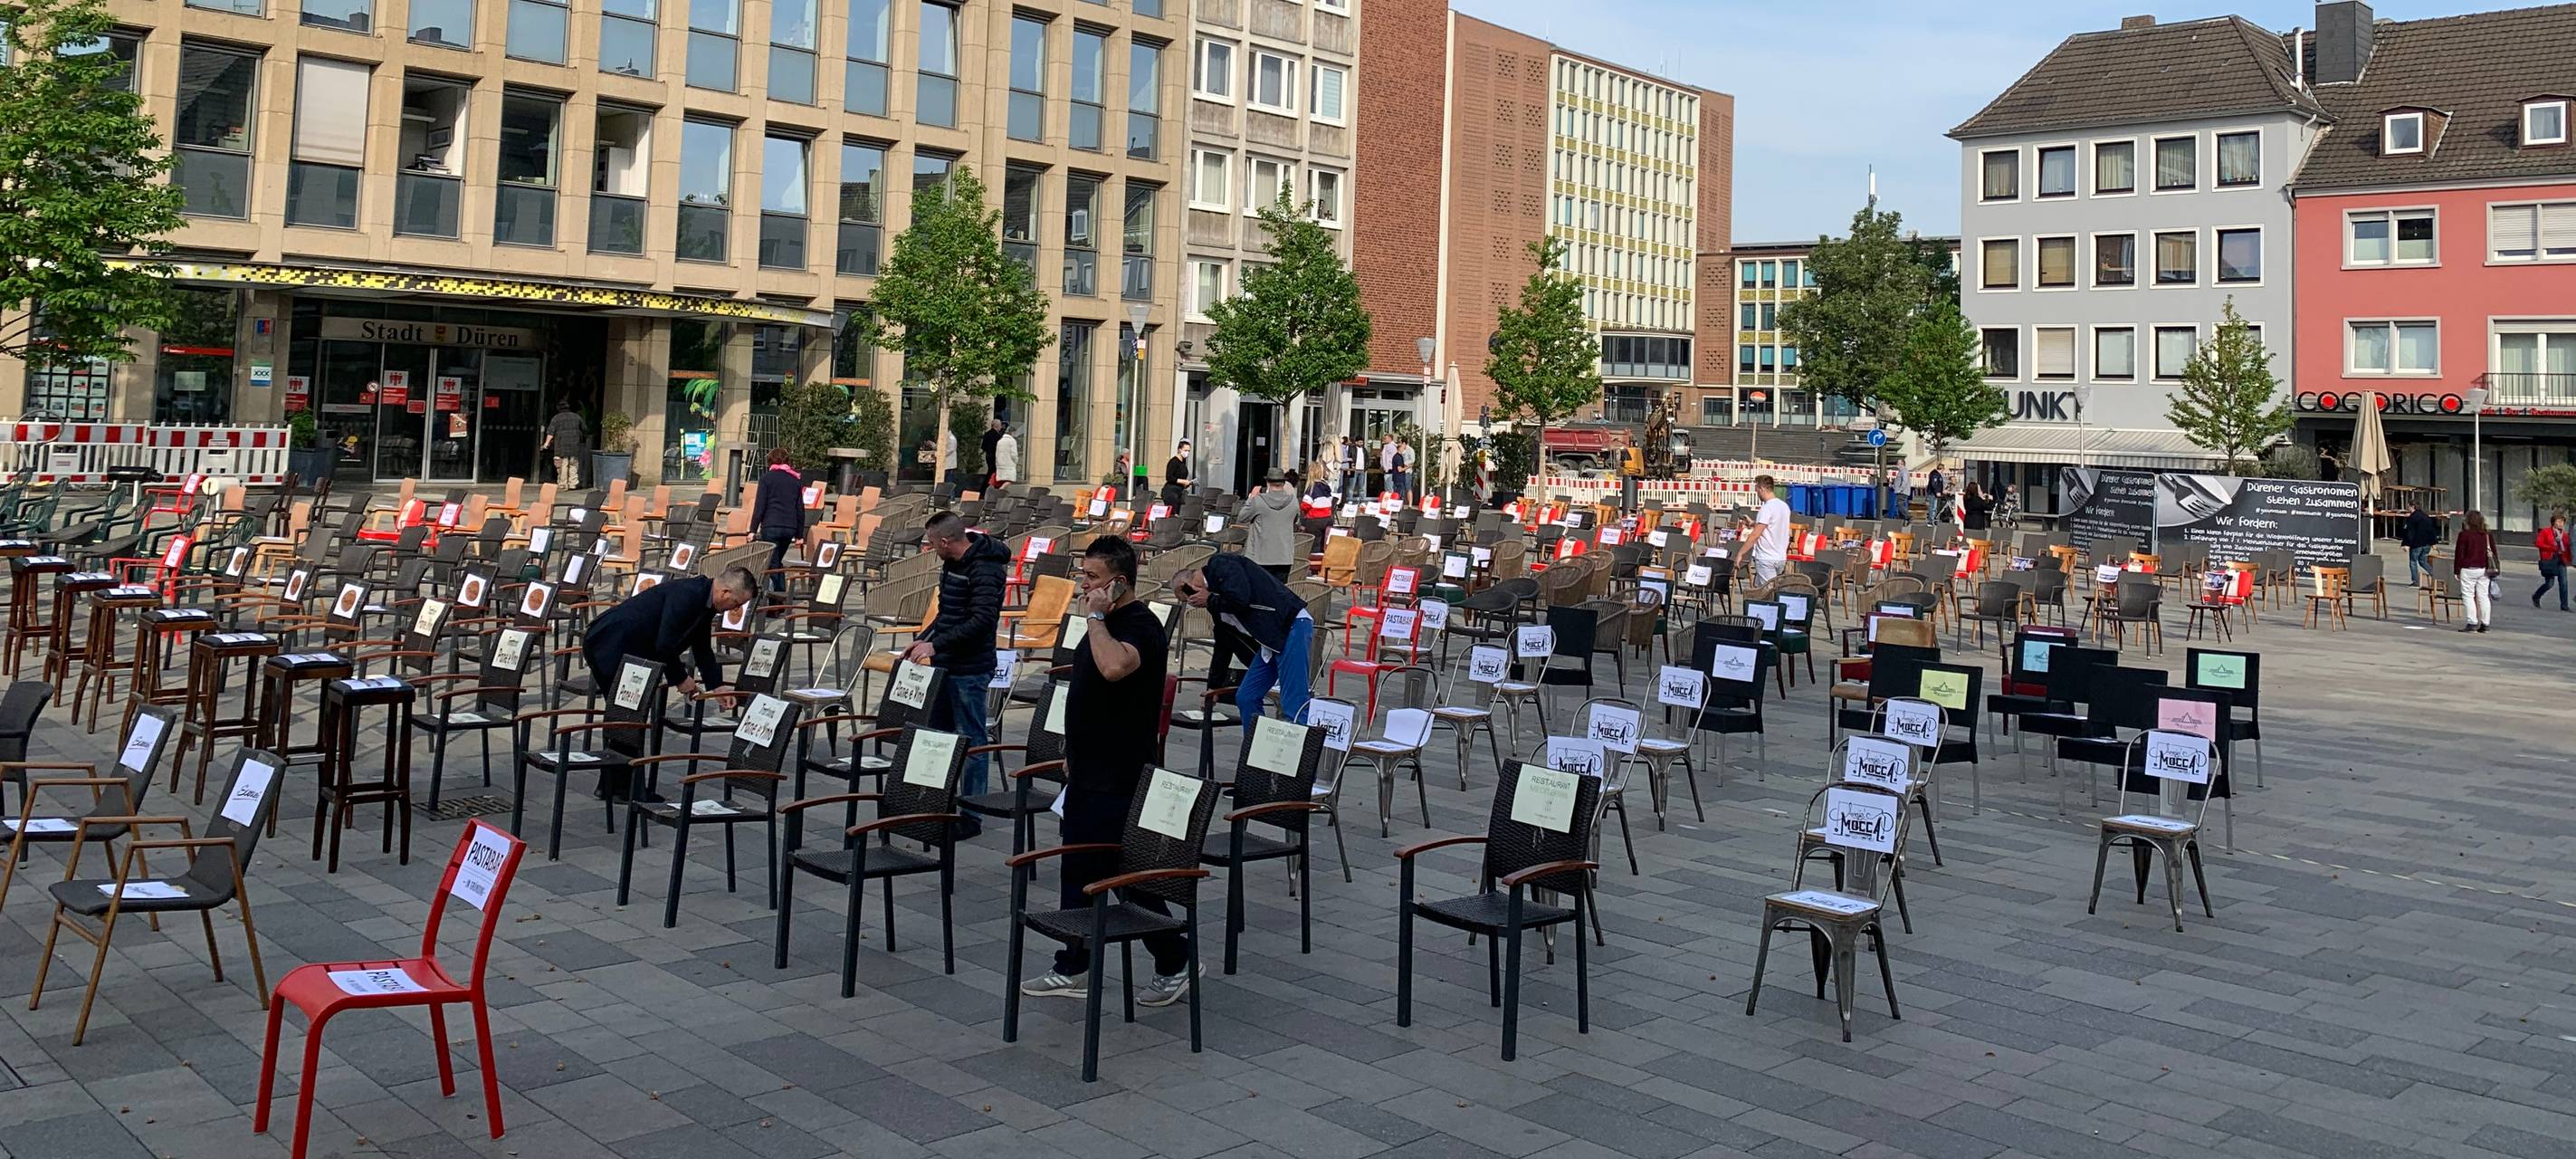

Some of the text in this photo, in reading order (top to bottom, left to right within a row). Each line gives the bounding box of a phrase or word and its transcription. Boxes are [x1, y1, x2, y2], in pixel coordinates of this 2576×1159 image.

[362, 321, 519, 347] Stadt Düren
[2247, 482, 2358, 497] Dürener Gastronomen
[2216, 515, 2278, 530] Wir fordern:
[1385, 614, 1412, 624] PASTABAR
[1524, 638, 1545, 652] MOCCA
[1478, 659, 1501, 677] MOCCA
[893, 680, 909, 698] Pane
[913, 685, 924, 704] Vino
[1668, 681, 1694, 701] MOCCA
[1597, 721, 1627, 744] MOCCA
[1897, 717, 1929, 739] MOCCA
[1859, 757, 1897, 783] MOCCA
[2160, 751, 2199, 775] MOCCA
[1531, 775, 1571, 790] RESTAURANT
[1840, 812, 1884, 842] MOCCA
